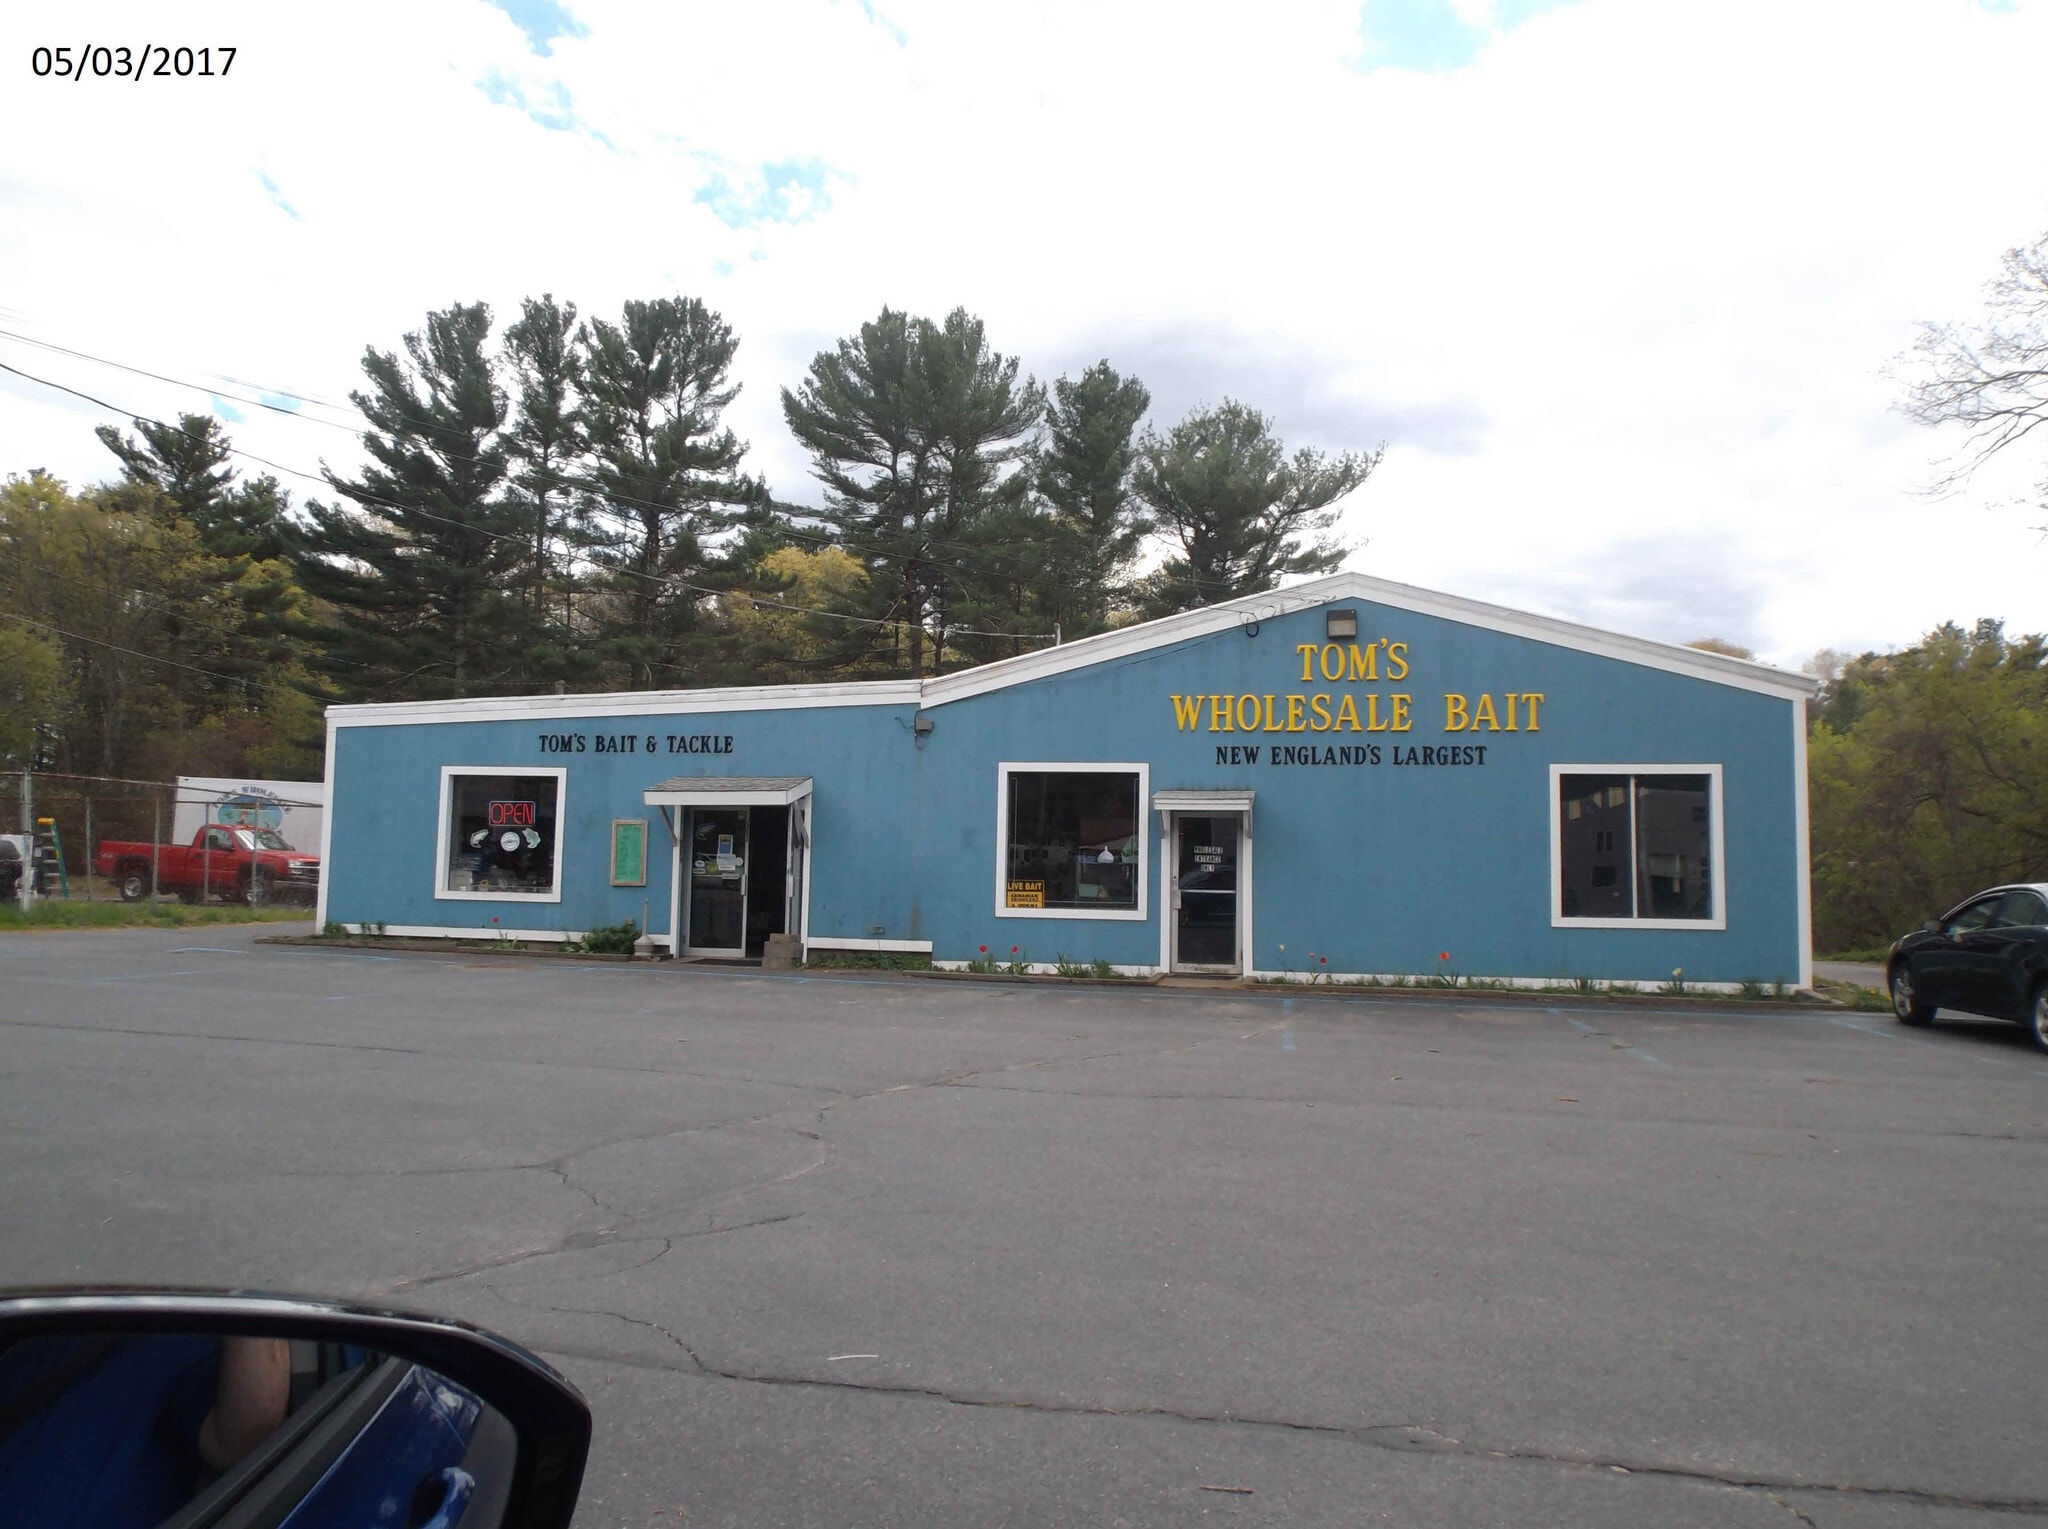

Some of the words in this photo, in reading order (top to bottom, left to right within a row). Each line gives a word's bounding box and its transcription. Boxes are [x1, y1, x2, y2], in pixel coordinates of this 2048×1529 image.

[1297, 637, 1409, 682] TOM'S
[1169, 693, 1413, 732] WHOLESALE
[1443, 693, 1545, 732] BAIT
[539, 733, 586, 753] TOM'S
[595, 735, 637, 753] BAIT
[646, 735, 657, 753] &
[666, 735, 734, 754] TACKLE
[1216, 746, 1260, 765] NEW
[1270, 742, 1381, 765] ENGLAND'S
[1393, 745, 1487, 765] LARGEST
[491, 803, 533, 824] OPEN
[1194, 854, 1222, 864] ENTRANCE
[1007, 882, 1024, 890] LIVE
[1025, 882, 1042, 891] BAIT
